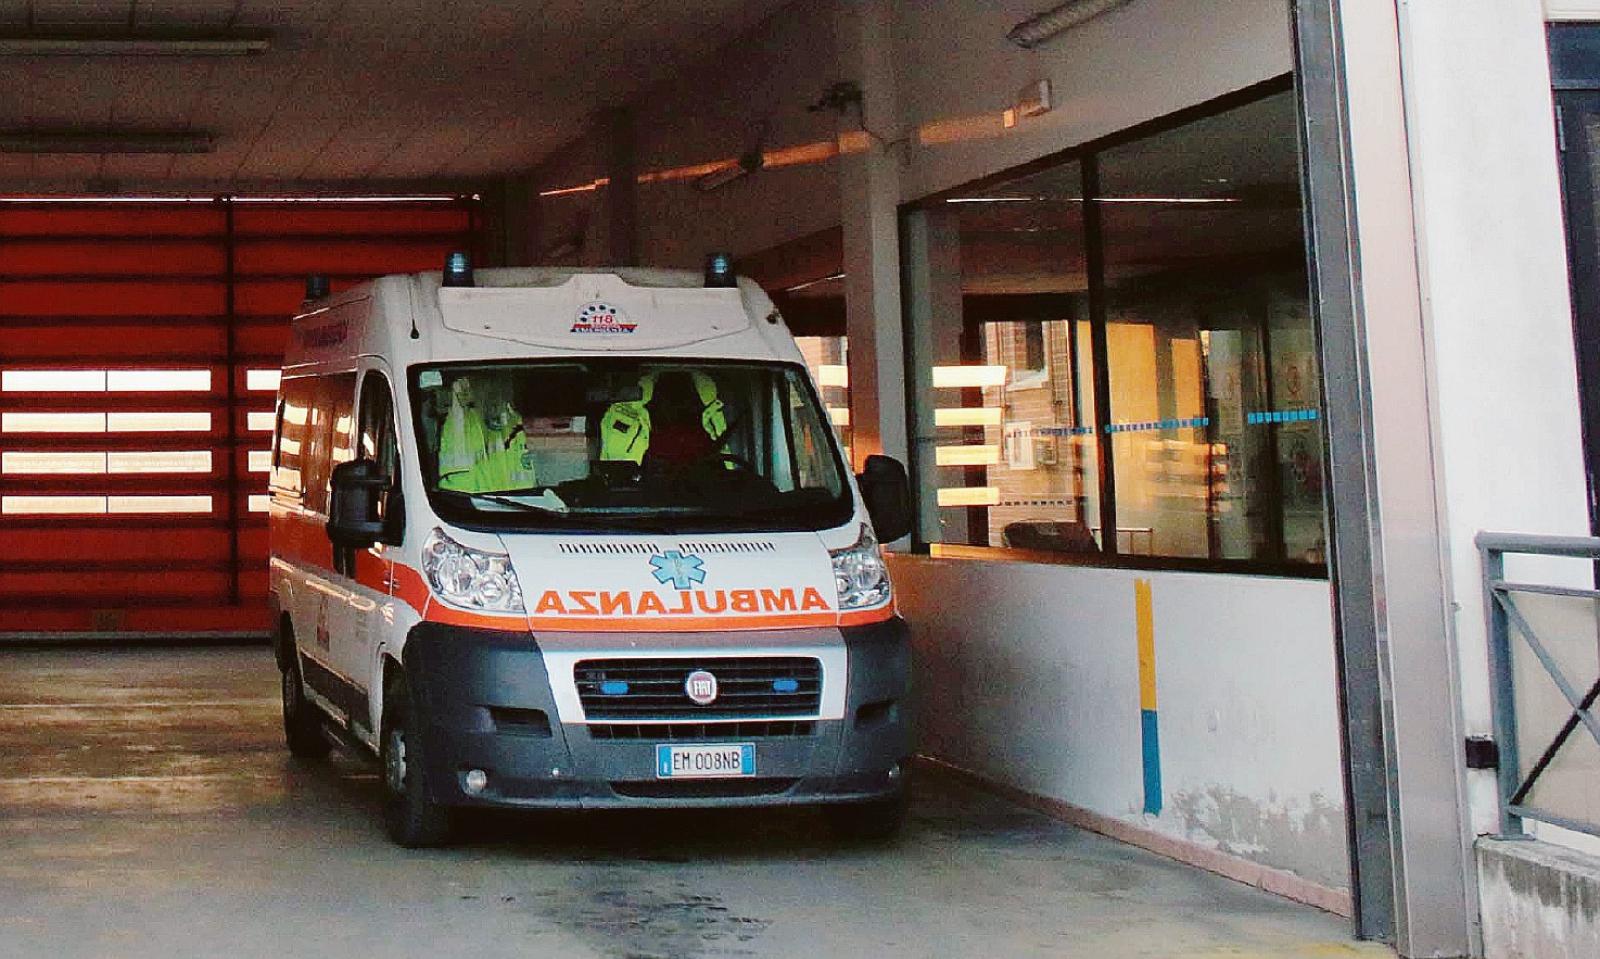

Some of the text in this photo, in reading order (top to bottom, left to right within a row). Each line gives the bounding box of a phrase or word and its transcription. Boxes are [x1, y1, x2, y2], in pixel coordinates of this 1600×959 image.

[592, 315, 613, 324] 118
[693, 680, 712, 696] FIAT
[673, 752, 690, 770] EM
